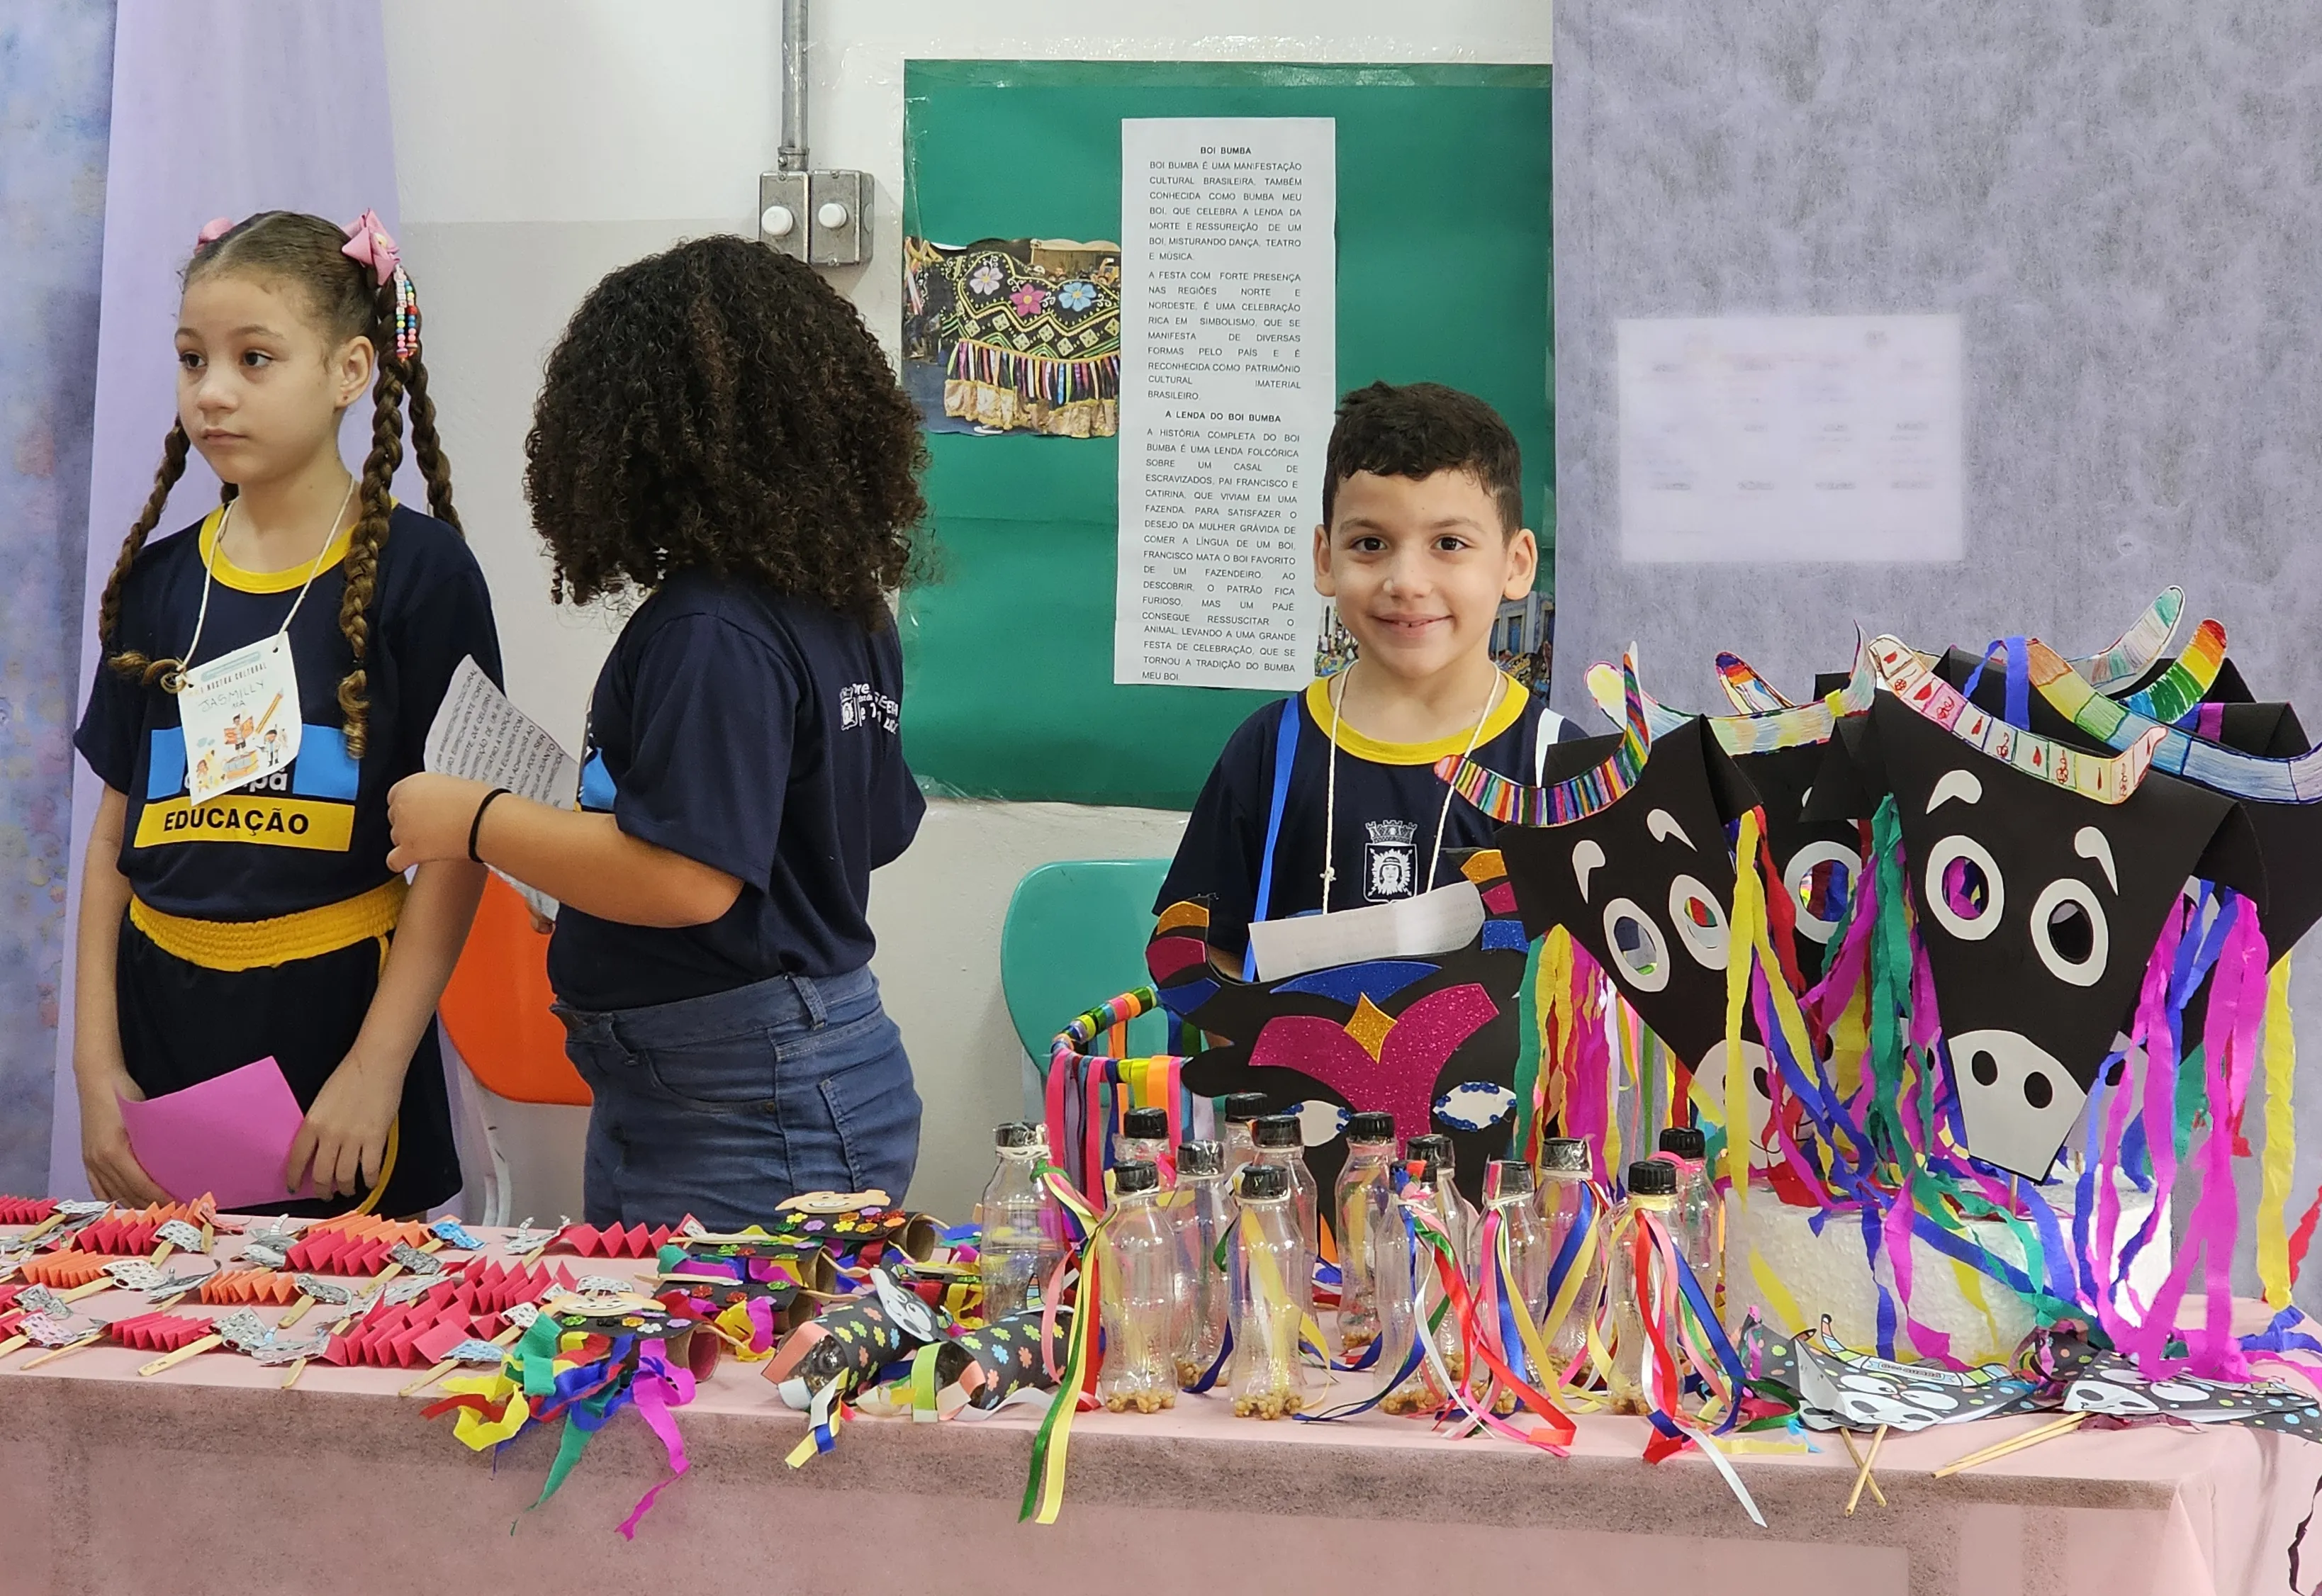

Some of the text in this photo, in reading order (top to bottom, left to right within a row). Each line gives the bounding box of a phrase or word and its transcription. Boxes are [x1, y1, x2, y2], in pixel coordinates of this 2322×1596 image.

[1200, 146, 1252, 155] BOI BUMBA
[1150, 160, 1302, 173] BOI BUMBA É UMA MANIFESTAÇÃO
[1149, 176, 1195, 185] CULTURAL
[1264, 176, 1302, 186] TAMBÉM
[1149, 191, 1302, 202] CONHECIDA COMO BUMBA MEU
[1172, 207, 1191, 215] QUE
[1196, 207, 1238, 216] CELEBRA
[1243, 208, 1249, 216] A
[1254, 208, 1284, 216] LENDA
[1289, 208, 1302, 217] DA
[1149, 222, 1302, 233] MORTE E RESSUREIÇÃO DE UM
[1168, 237, 1227, 247] MISTURANDO
[1265, 238, 1301, 247] TEATRO
[1148, 252, 1155, 261] E
[1148, 271, 1301, 283] A FESTA COM FORTE PRESENÇA
[1148, 285, 1301, 298] NAS REGIÕES NORTE E
[1204, 300, 1210, 310] É
[1216, 302, 1236, 311] UMA
[1241, 303, 1301, 314] CELEBRAÇÃO
[1148, 316, 1170, 325] RICA
[1175, 317, 1188, 325] EM
[1263, 318, 1283, 327] QUE
[1289, 319, 1301, 327] SE
[1148, 331, 1301, 343] MANIFESTA DE DIVERSAS
[1148, 346, 1301, 358] FORMAS PELO PAÍS E É
[1148, 361, 1301, 373] RECONHECIDA COMO PATRIMÔNIO
[1148, 374, 1301, 389] CULTURAL IMATERIAL
[1165, 410, 1281, 423] A LENDA DO BOI BUMBA
[1146, 427, 1300, 443] A HISTÓRIA COMPLETA DO BOI
[1146, 443, 1177, 453] BUMBA
[1180, 443, 1186, 453] É
[1190, 445, 1211, 454] UMA
[1214, 446, 1243, 456] LENDA
[1145, 458, 1299, 473] SOBRE UM CASAL DE
[1218, 477, 1233, 485] PAI
[1236, 478, 1289, 488] FRANCISCO
[1291, 480, 1299, 489] E
[1194, 491, 1213, 500] QUE
[1220, 493, 1250, 502] VIVIAM
[1257, 494, 1271, 502] EM
[1277, 495, 1298, 504] UMA
[1194, 507, 1220, 516] PARA
[1227, 508, 1281, 519] SATISFAZER
[1289, 510, 1297, 519] O
[1144, 519, 1296, 535] DESEJO DA MULHER GRÁVIDA DE
[1143, 534, 1175, 544] COMER
[1182, 536, 1189, 545] A
[1196, 536, 1230, 547] LÍNGUA
[1236, 539, 1249, 548] DE
[1256, 540, 1271, 549] UM
[1143, 550, 1296, 566] FRANCISCO MATA O BOI FAVORITO
[1143, 565, 1155, 574] DE
[1173, 566, 1187, 575] UM
[1281, 572, 1296, 580] AO
[1206, 583, 1215, 592] O
[1226, 585, 1263, 595] PATRÃO
[1274, 587, 1296, 596] FICA
[1201, 599, 1221, 608] MAS
[1240, 601, 1254, 609] UM
[1272, 602, 1294, 612] PAJÉ
[1142, 612, 1294, 627] CONSEGUE RESSUSCITAR O
[1181, 627, 1223, 638] LEVANDO
[1226, 630, 1233, 639] A
[1235, 630, 1256, 639] UMA
[1258, 631, 1296, 641] GRANDE
[1143, 640, 1172, 650] FESTA
[1177, 642, 1189, 651] DE
[1259, 647, 1279, 656] QUE
[1284, 648, 1296, 657] SE
[1143, 656, 1181, 666] TORNOU
[1196, 658, 1241, 670] TRADIÇÃO
[1245, 661, 1260, 670] DO
[1264, 663, 1296, 673] BUMBA
[1142, 670, 1162, 680] MEU
[533, 733, 546, 753] SER
[539, 743, 556, 774] QUANTO
[163, 807, 309, 837] EDUCAÇÃO
